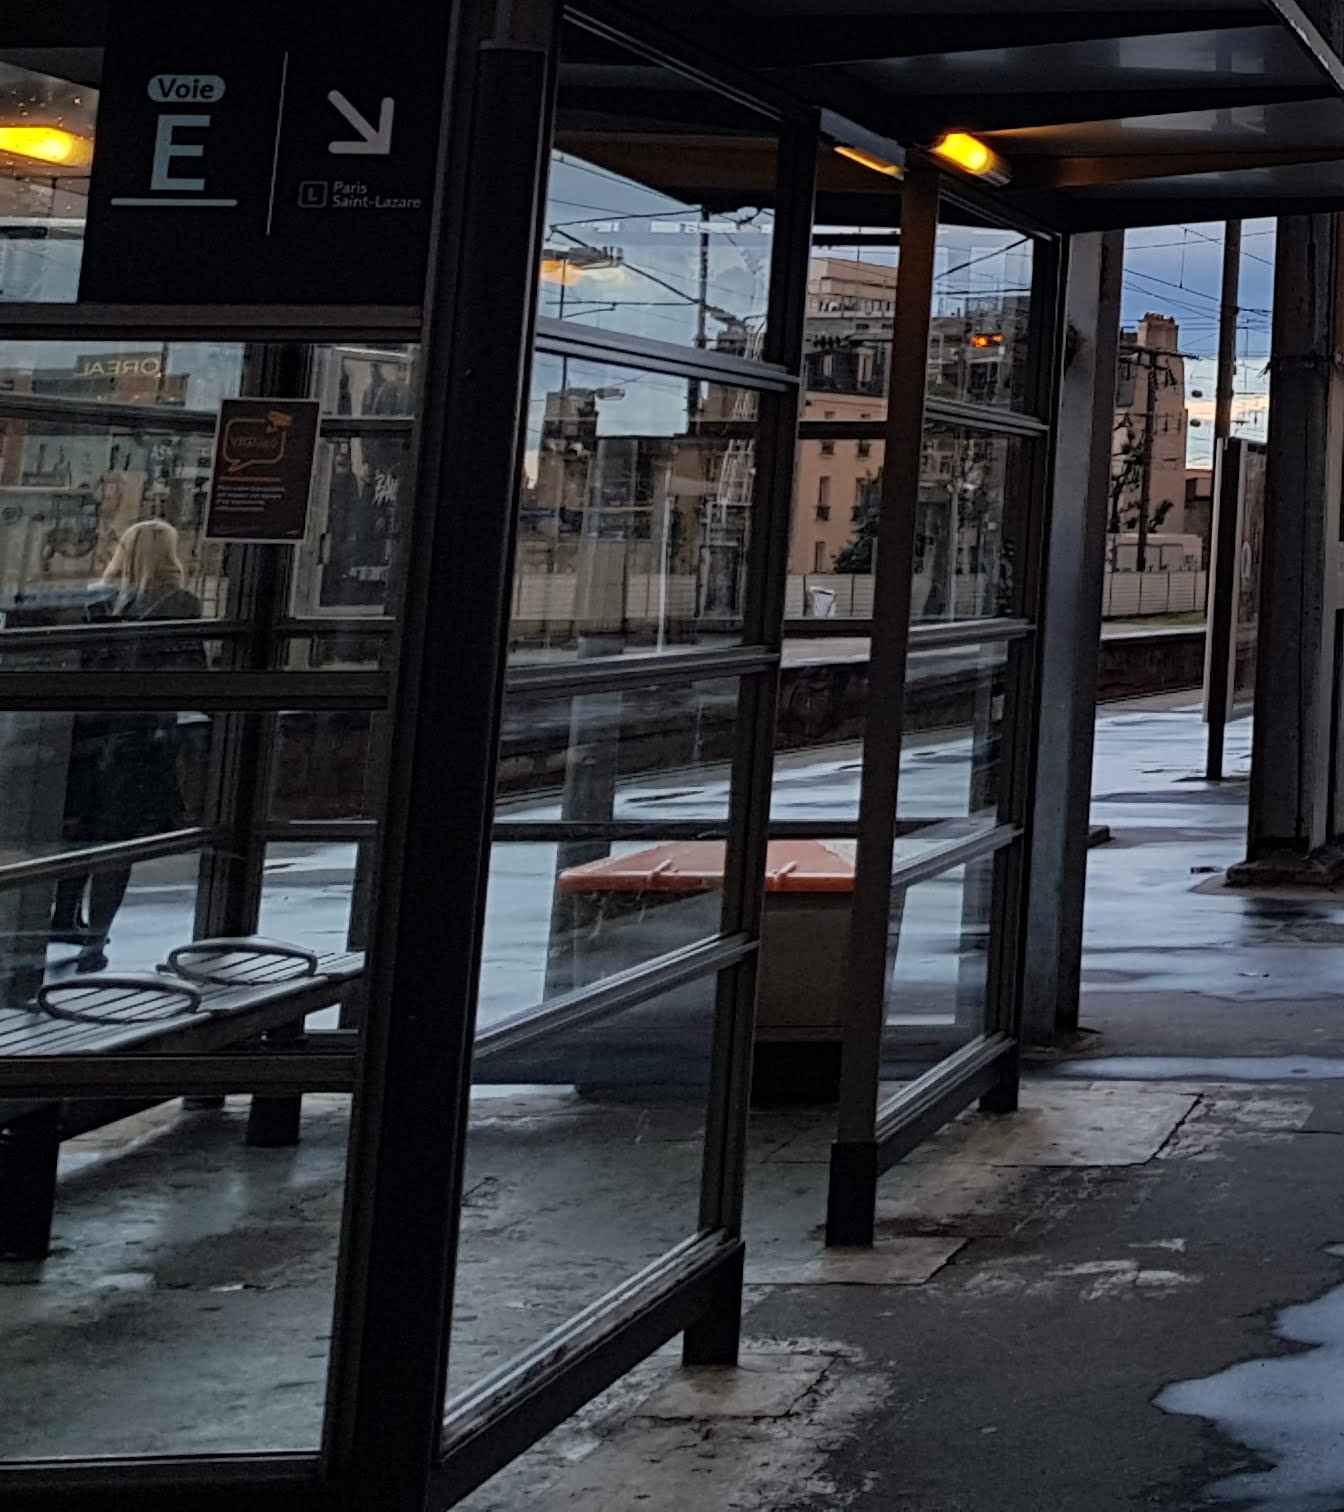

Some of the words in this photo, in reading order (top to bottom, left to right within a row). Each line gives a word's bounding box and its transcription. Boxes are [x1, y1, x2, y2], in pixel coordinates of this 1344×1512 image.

[158, 78, 215, 99] Voie
[150, 114, 211, 191] E
[333, 181, 368, 194] Paris
[332, 194, 421, 208] Saint-Lazare
